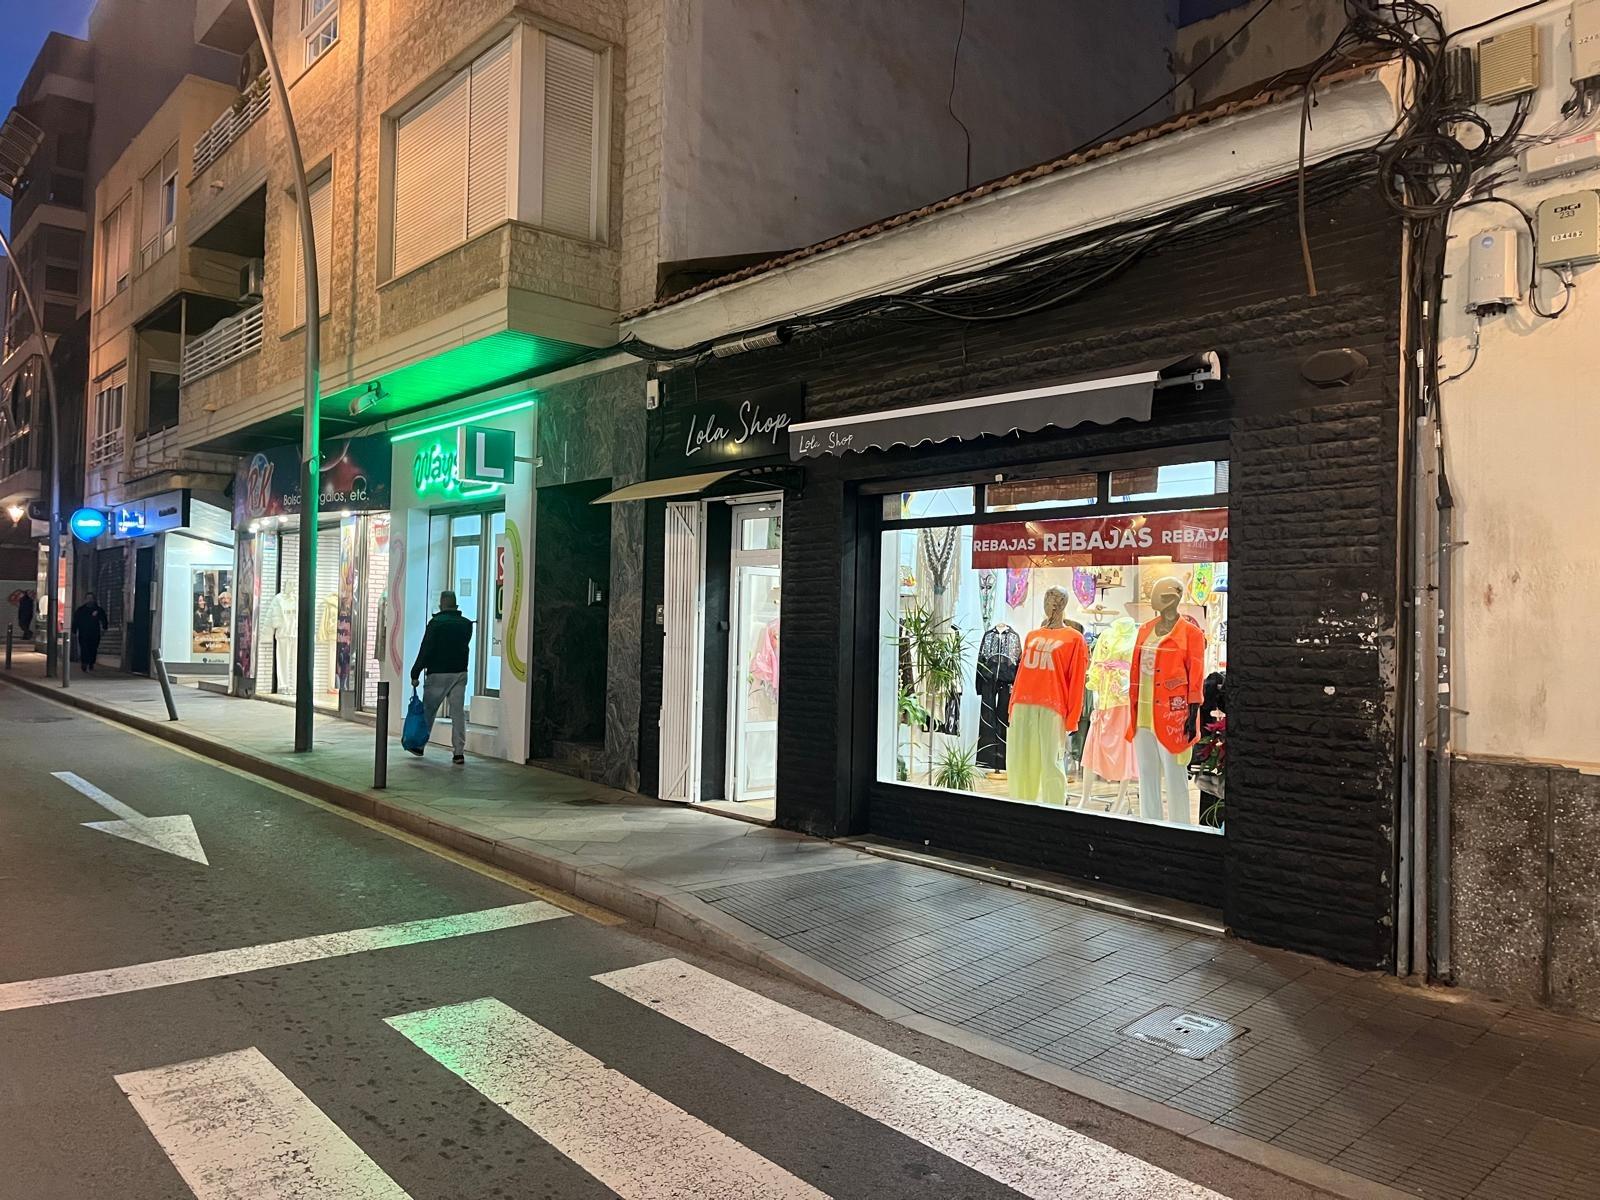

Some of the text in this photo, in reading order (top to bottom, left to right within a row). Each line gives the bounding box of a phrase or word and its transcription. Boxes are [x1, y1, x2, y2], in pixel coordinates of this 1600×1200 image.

[1554, 203, 1581, 213] DIGI
[1559, 210, 1575, 219] 233
[685, 400, 791, 457] Lola Shop
[799, 431, 854, 453] Lola Shop
[475, 432, 505, 478] L
[350, 489, 370, 501] etc.
[973, 538, 1036, 552] REBAJAS
[1043, 528, 1153, 552] REBAJAS
